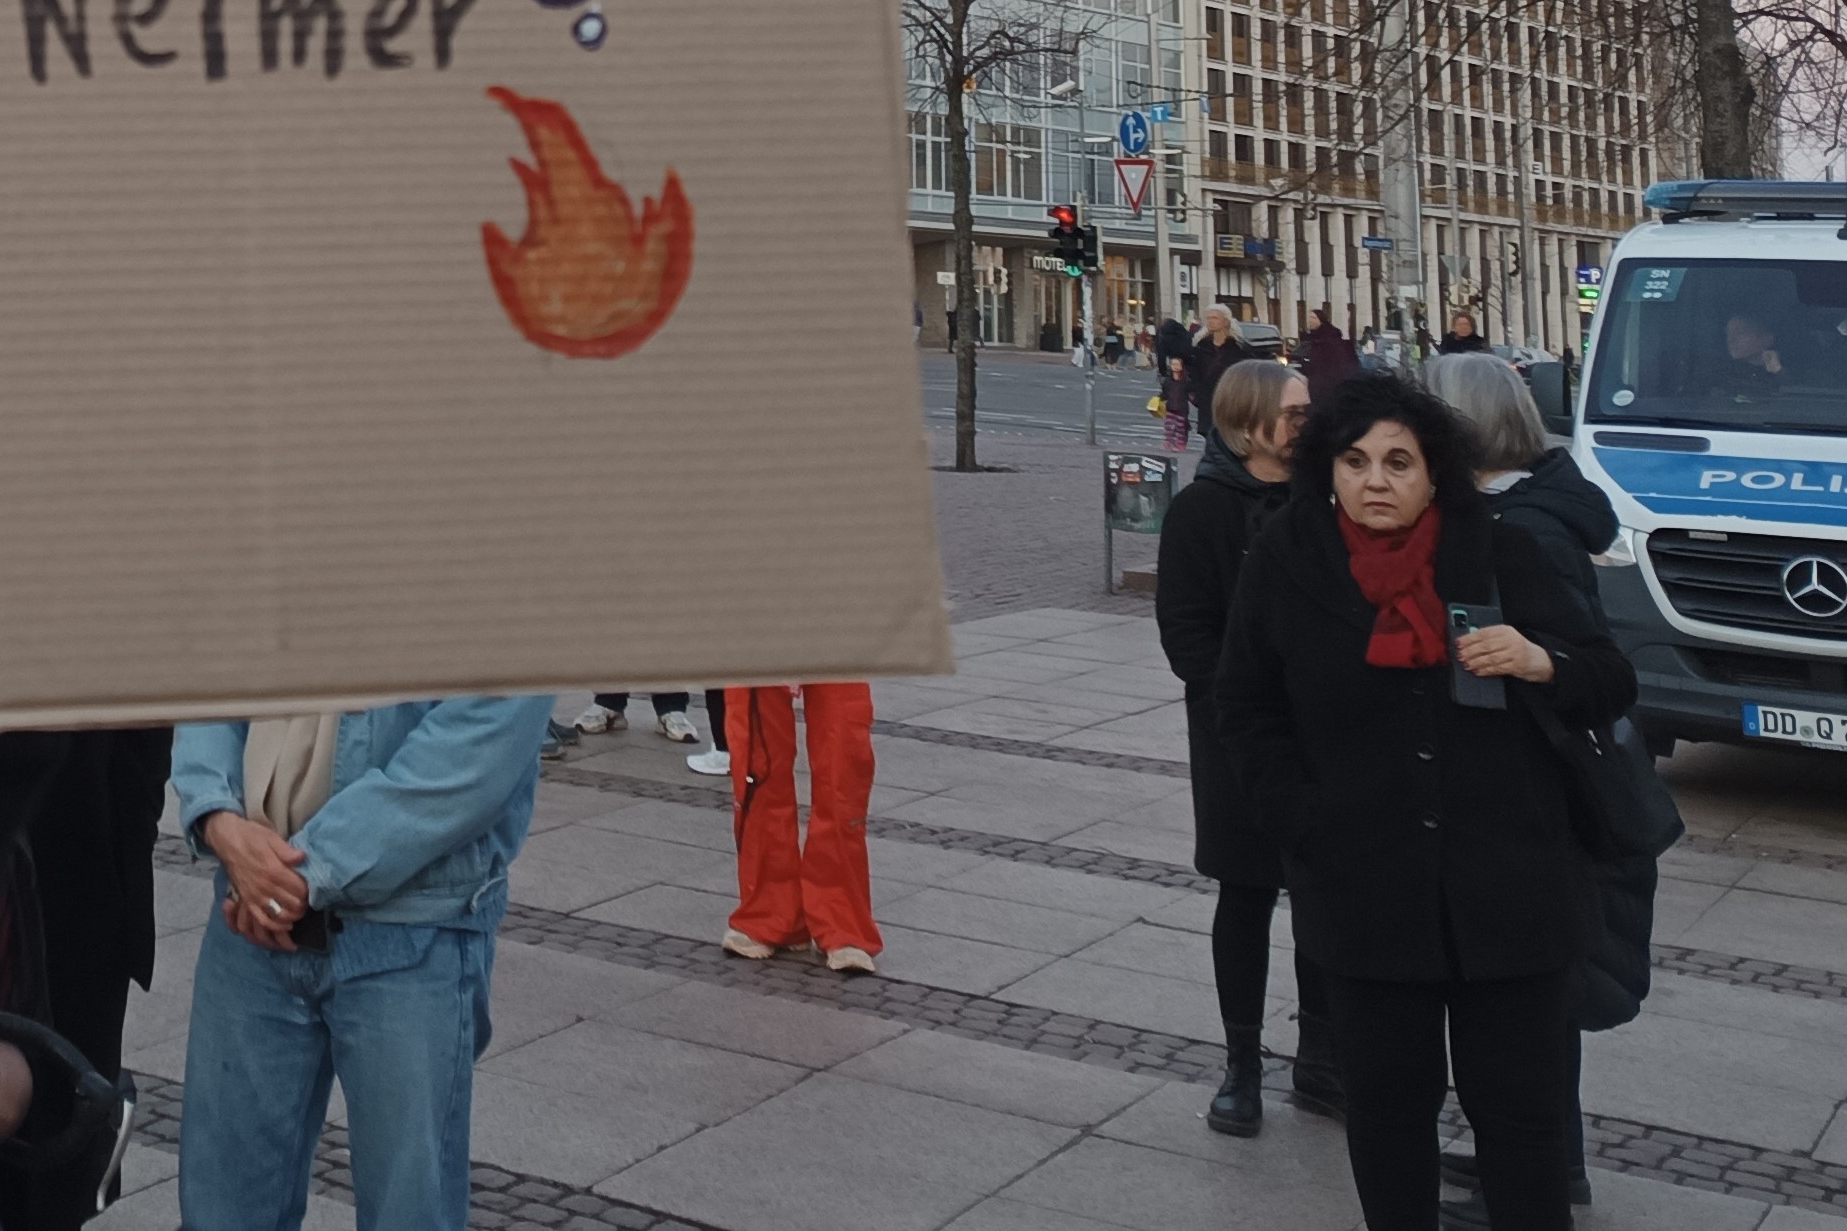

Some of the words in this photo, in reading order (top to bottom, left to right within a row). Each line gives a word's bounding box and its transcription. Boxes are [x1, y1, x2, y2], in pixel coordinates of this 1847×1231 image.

[1033, 255, 1067, 271] MOTEL
[1590, 269, 1601, 283] P
[1650, 269, 1670, 278] SN
[1645, 280, 1669, 289] 322
[1762, 710, 1797, 736] DD
